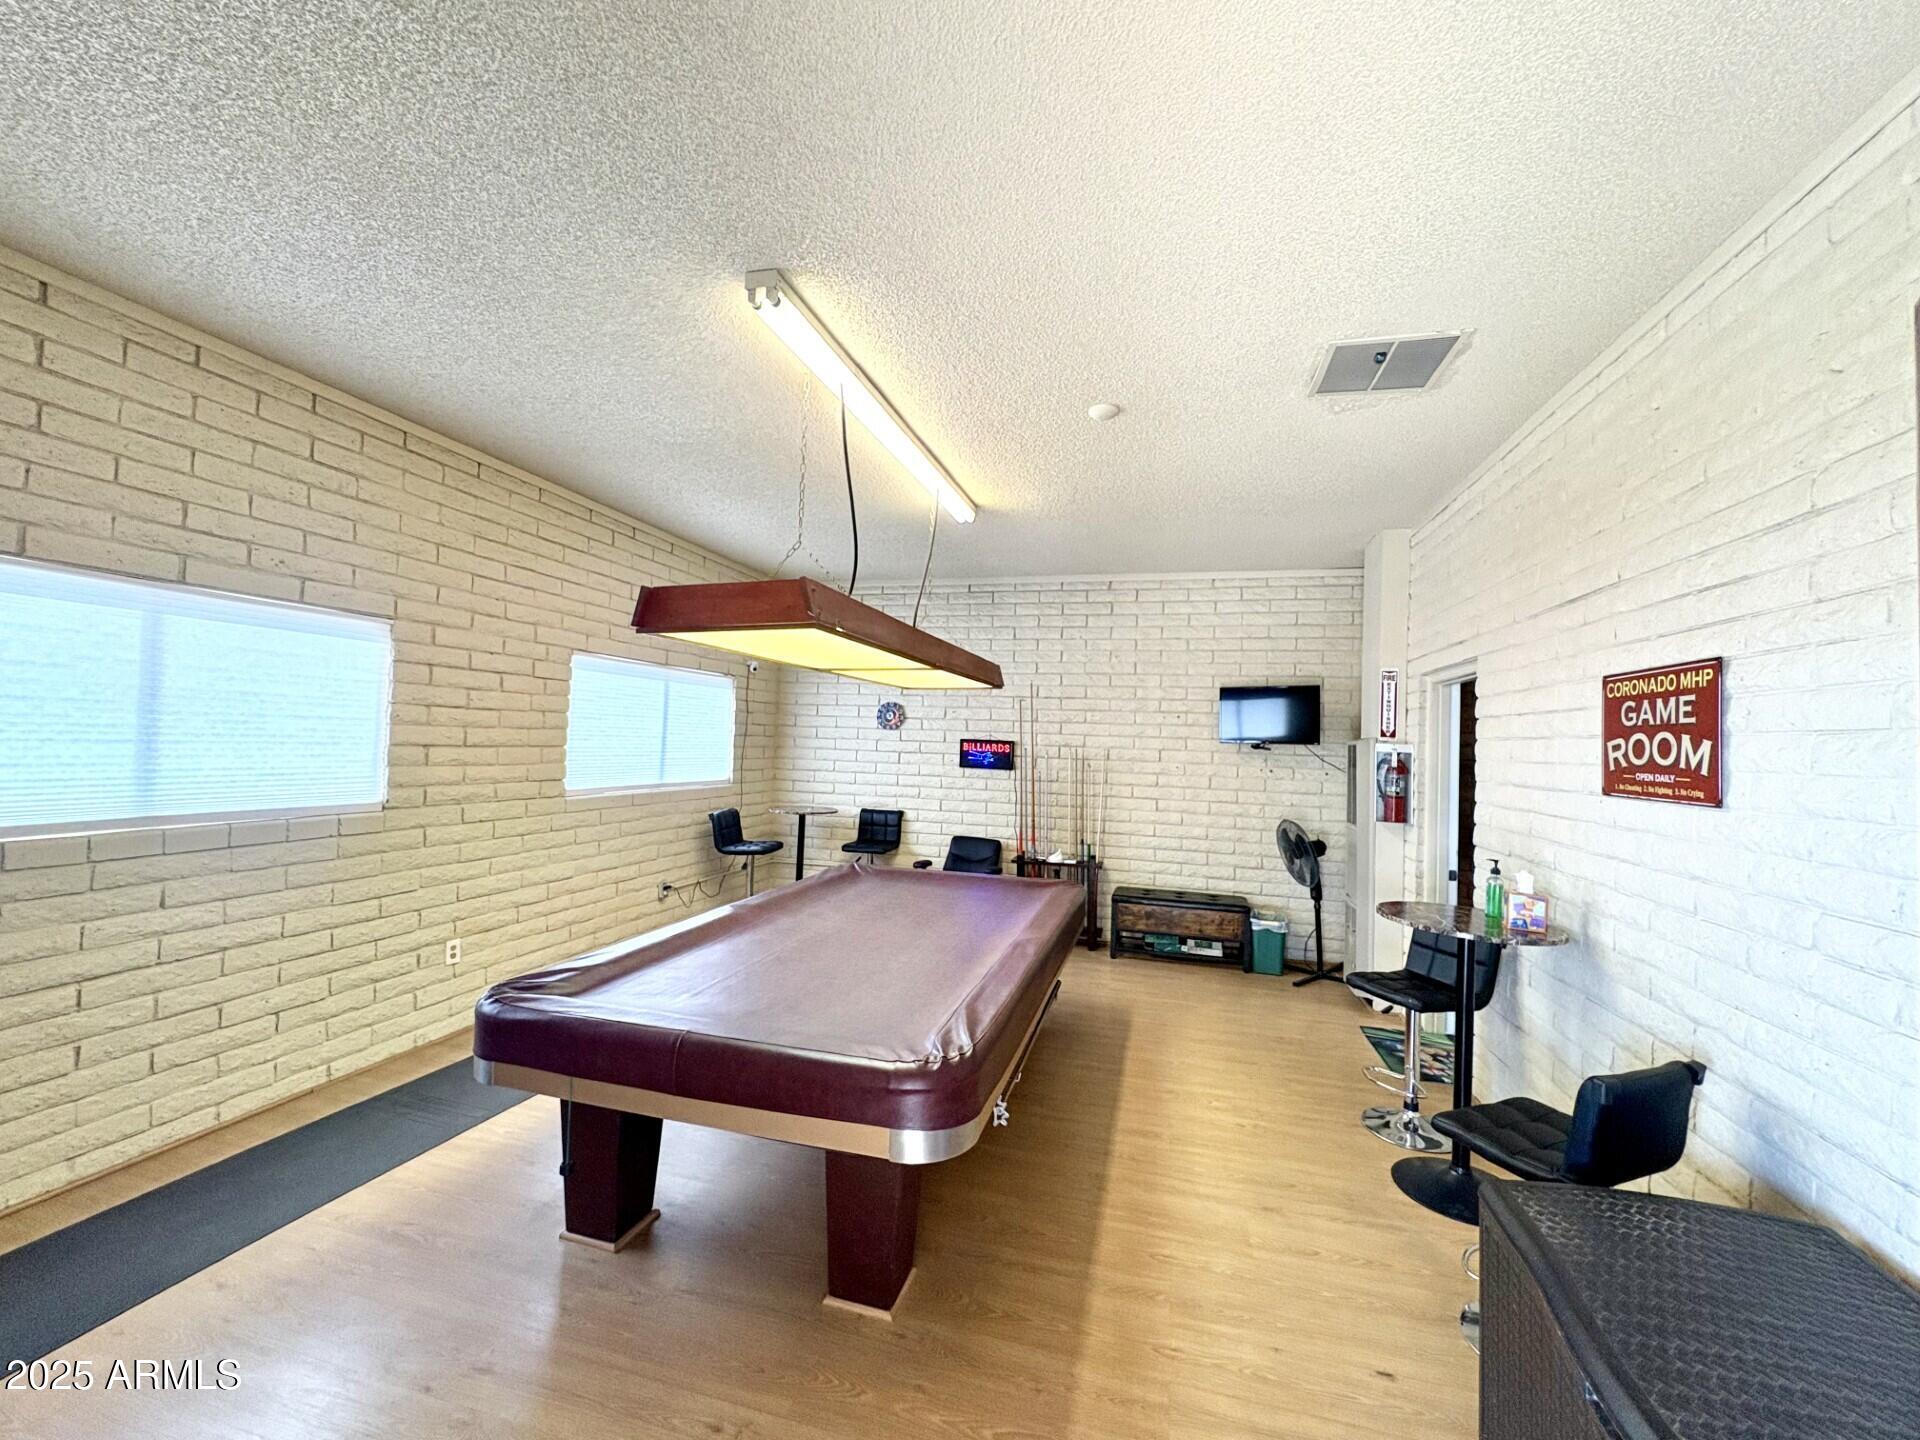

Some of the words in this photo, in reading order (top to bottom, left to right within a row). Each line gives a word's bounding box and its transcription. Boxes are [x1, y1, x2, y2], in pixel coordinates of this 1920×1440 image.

[1607, 675, 1677, 698] CORONADO
[1680, 669, 1713, 690] MHP
[1620, 694, 1696, 727] GAME
[962, 742, 1010, 753] BILLIARDS
[1606, 731, 1713, 776] ROOM
[1635, 773, 1654, 782] OPEN
[1655, 774, 1675, 783] DAILY
